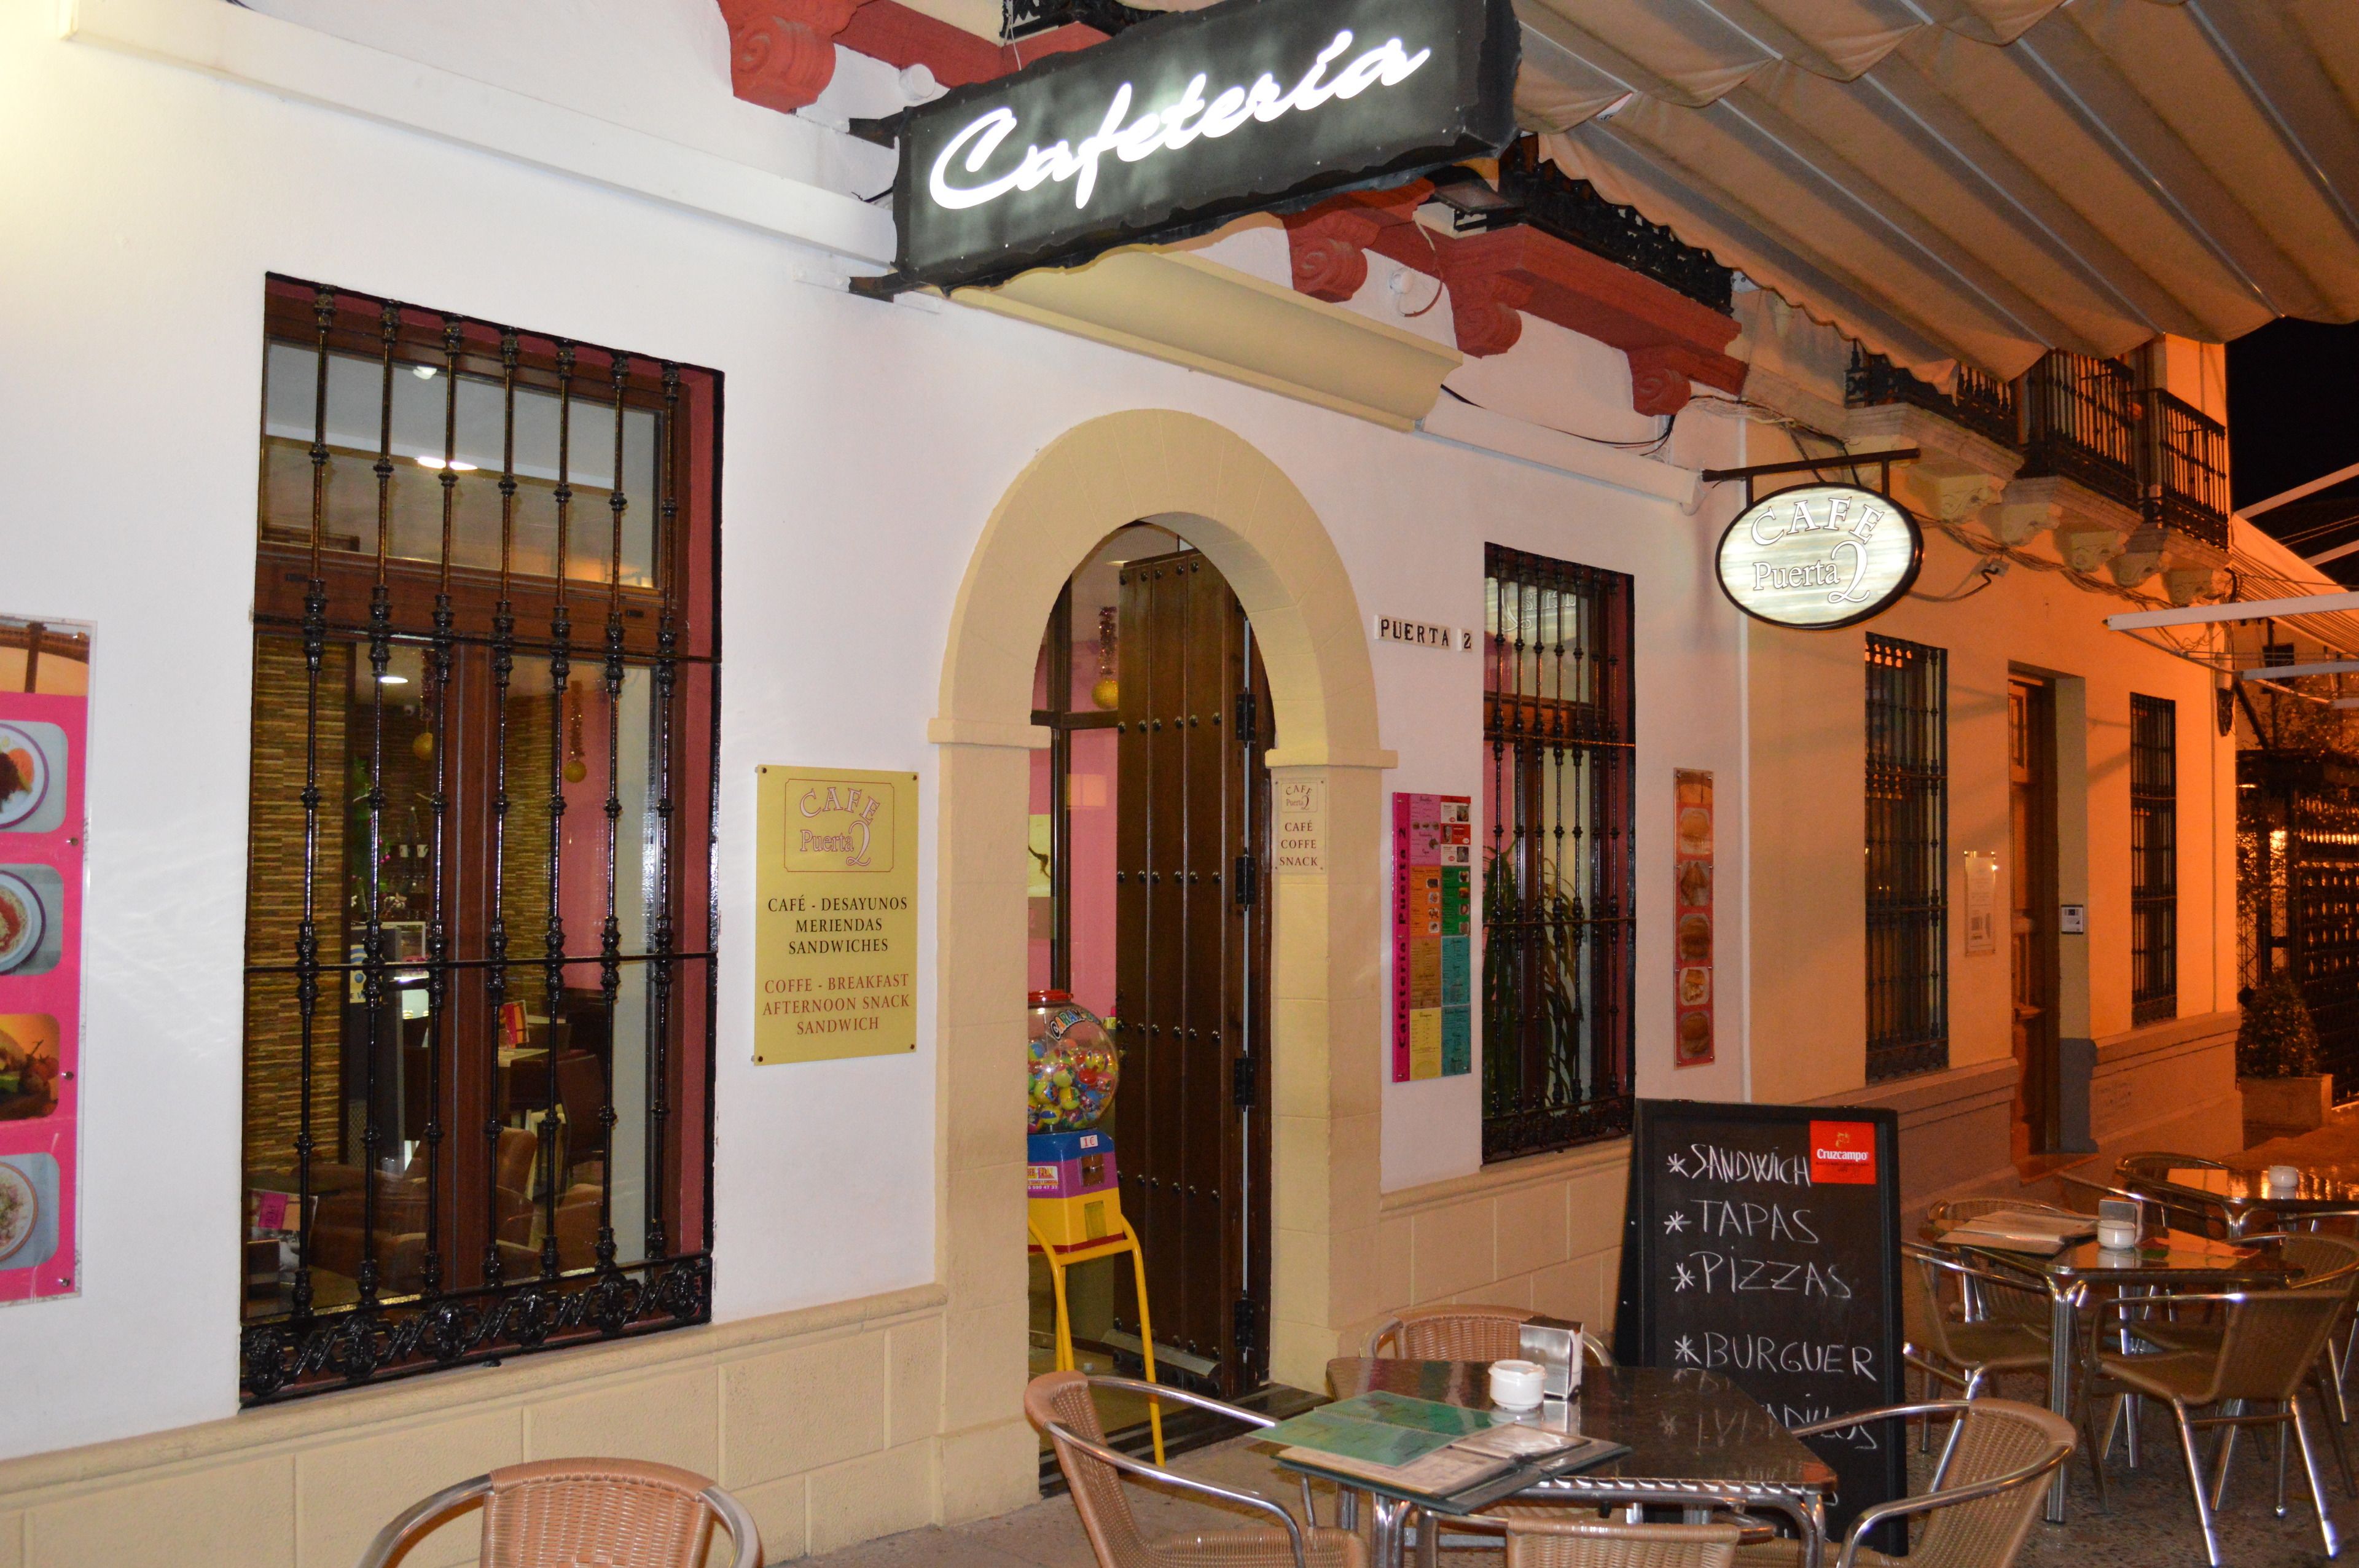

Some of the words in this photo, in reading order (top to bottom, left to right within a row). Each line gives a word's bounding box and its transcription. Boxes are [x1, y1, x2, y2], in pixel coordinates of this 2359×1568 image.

[1751, 496, 1885, 544] CAFE
[1753, 560, 1841, 590] Puerta
[1828, 540, 1871, 604] 2
[1380, 618, 1449, 647] PUERTA
[1463, 633, 1471, 649] 2
[800, 787, 880, 824] CAFE
[1285, 820, 1313, 832] CAFÉ
[800, 829, 854, 852] Puerta
[846, 821, 871, 867] 2
[1281, 840, 1316, 849] COFFE
[1279, 857, 1318, 866] SNACK
[768, 894, 805, 912] CAFÉ
[821, 896, 907, 911] DESAYUNOS
[796, 918, 882, 933] MERIENDAS
[789, 938, 888, 954] SANDWICHES
[765, 977, 812, 993] COFFE
[828, 974, 909, 991] BREAKFAST
[763, 997, 856, 1015] AFTERNOON
[863, 994, 910, 1009] SNACK
[797, 1016, 878, 1035] SANDWICH
[1084, 1136, 1095, 1147] 1€
[1817, 1149, 1868, 1162] Cruzcampo
[1689, 1199, 1818, 1244] TAPAS
[1704, 1332, 1877, 1382] BURGUER
